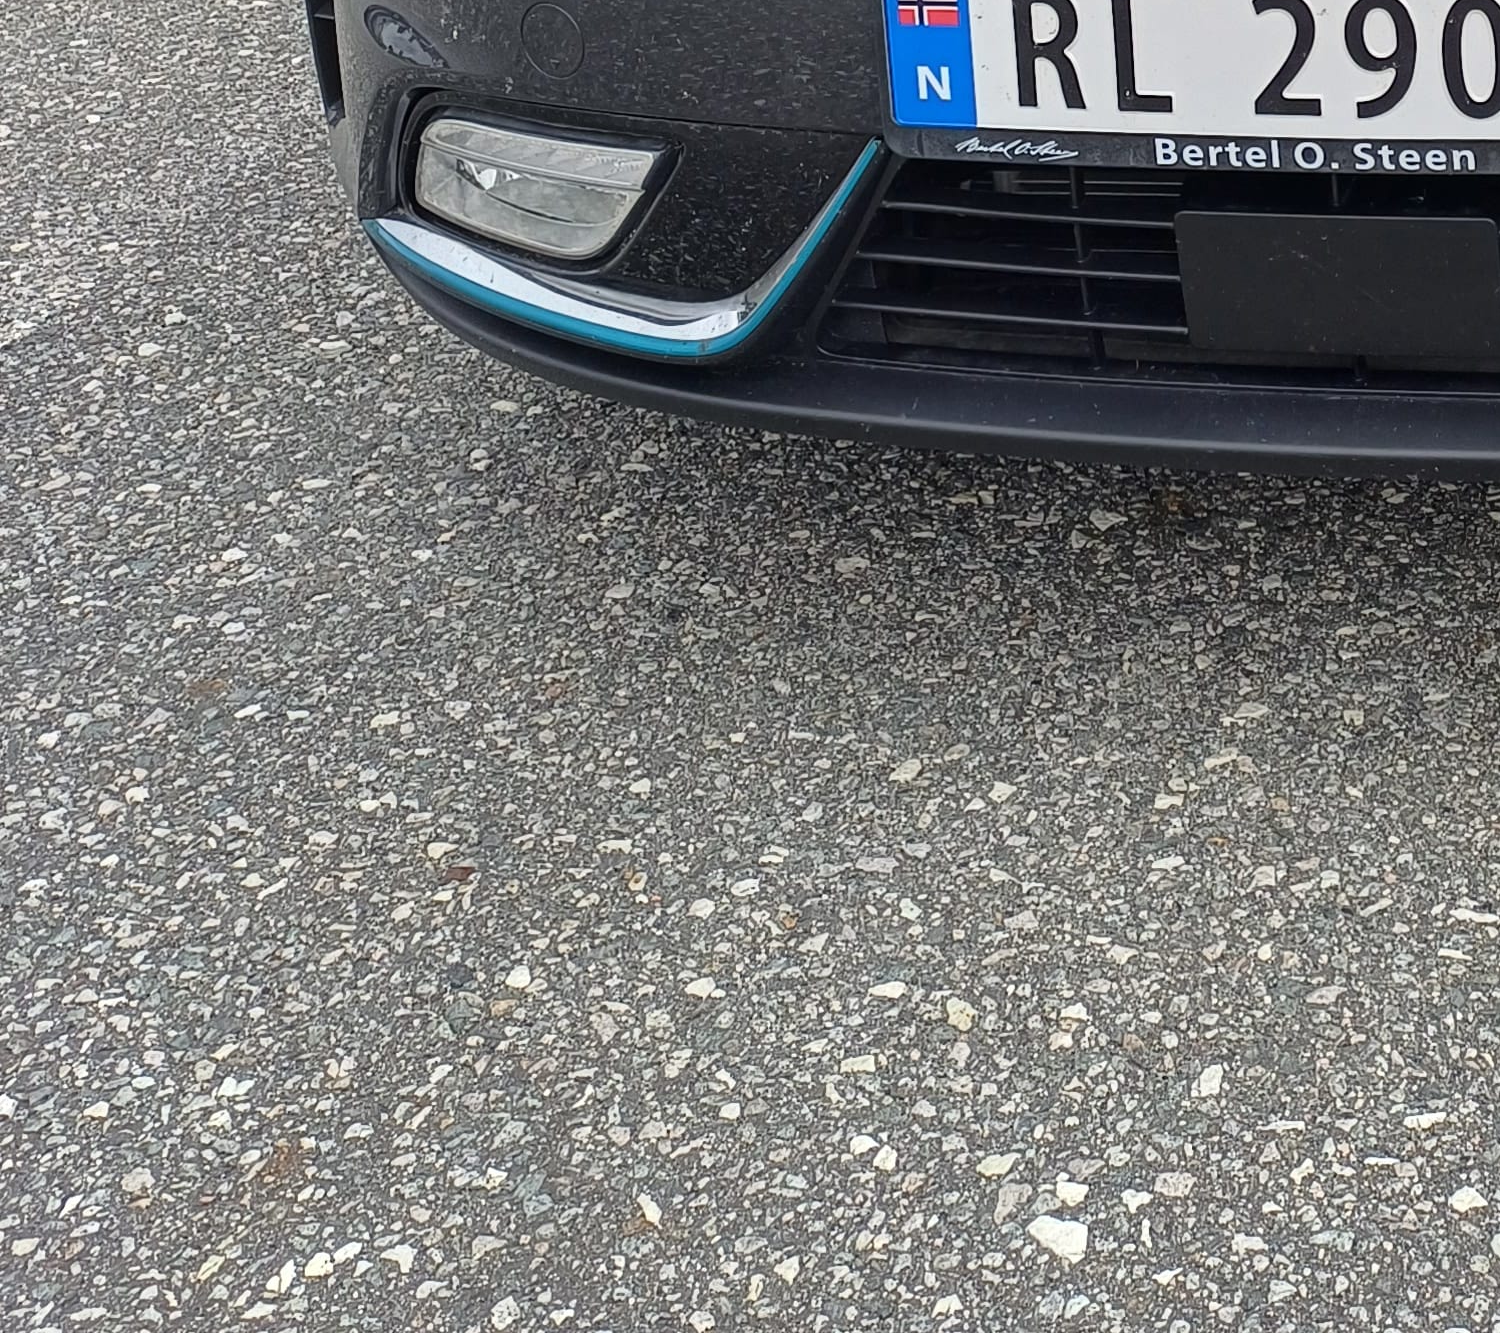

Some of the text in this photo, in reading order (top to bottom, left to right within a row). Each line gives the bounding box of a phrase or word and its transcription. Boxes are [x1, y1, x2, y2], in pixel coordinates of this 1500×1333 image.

[917, 66, 951, 100] N
[1154, 138, 1476, 171] Bertel O. Steen
